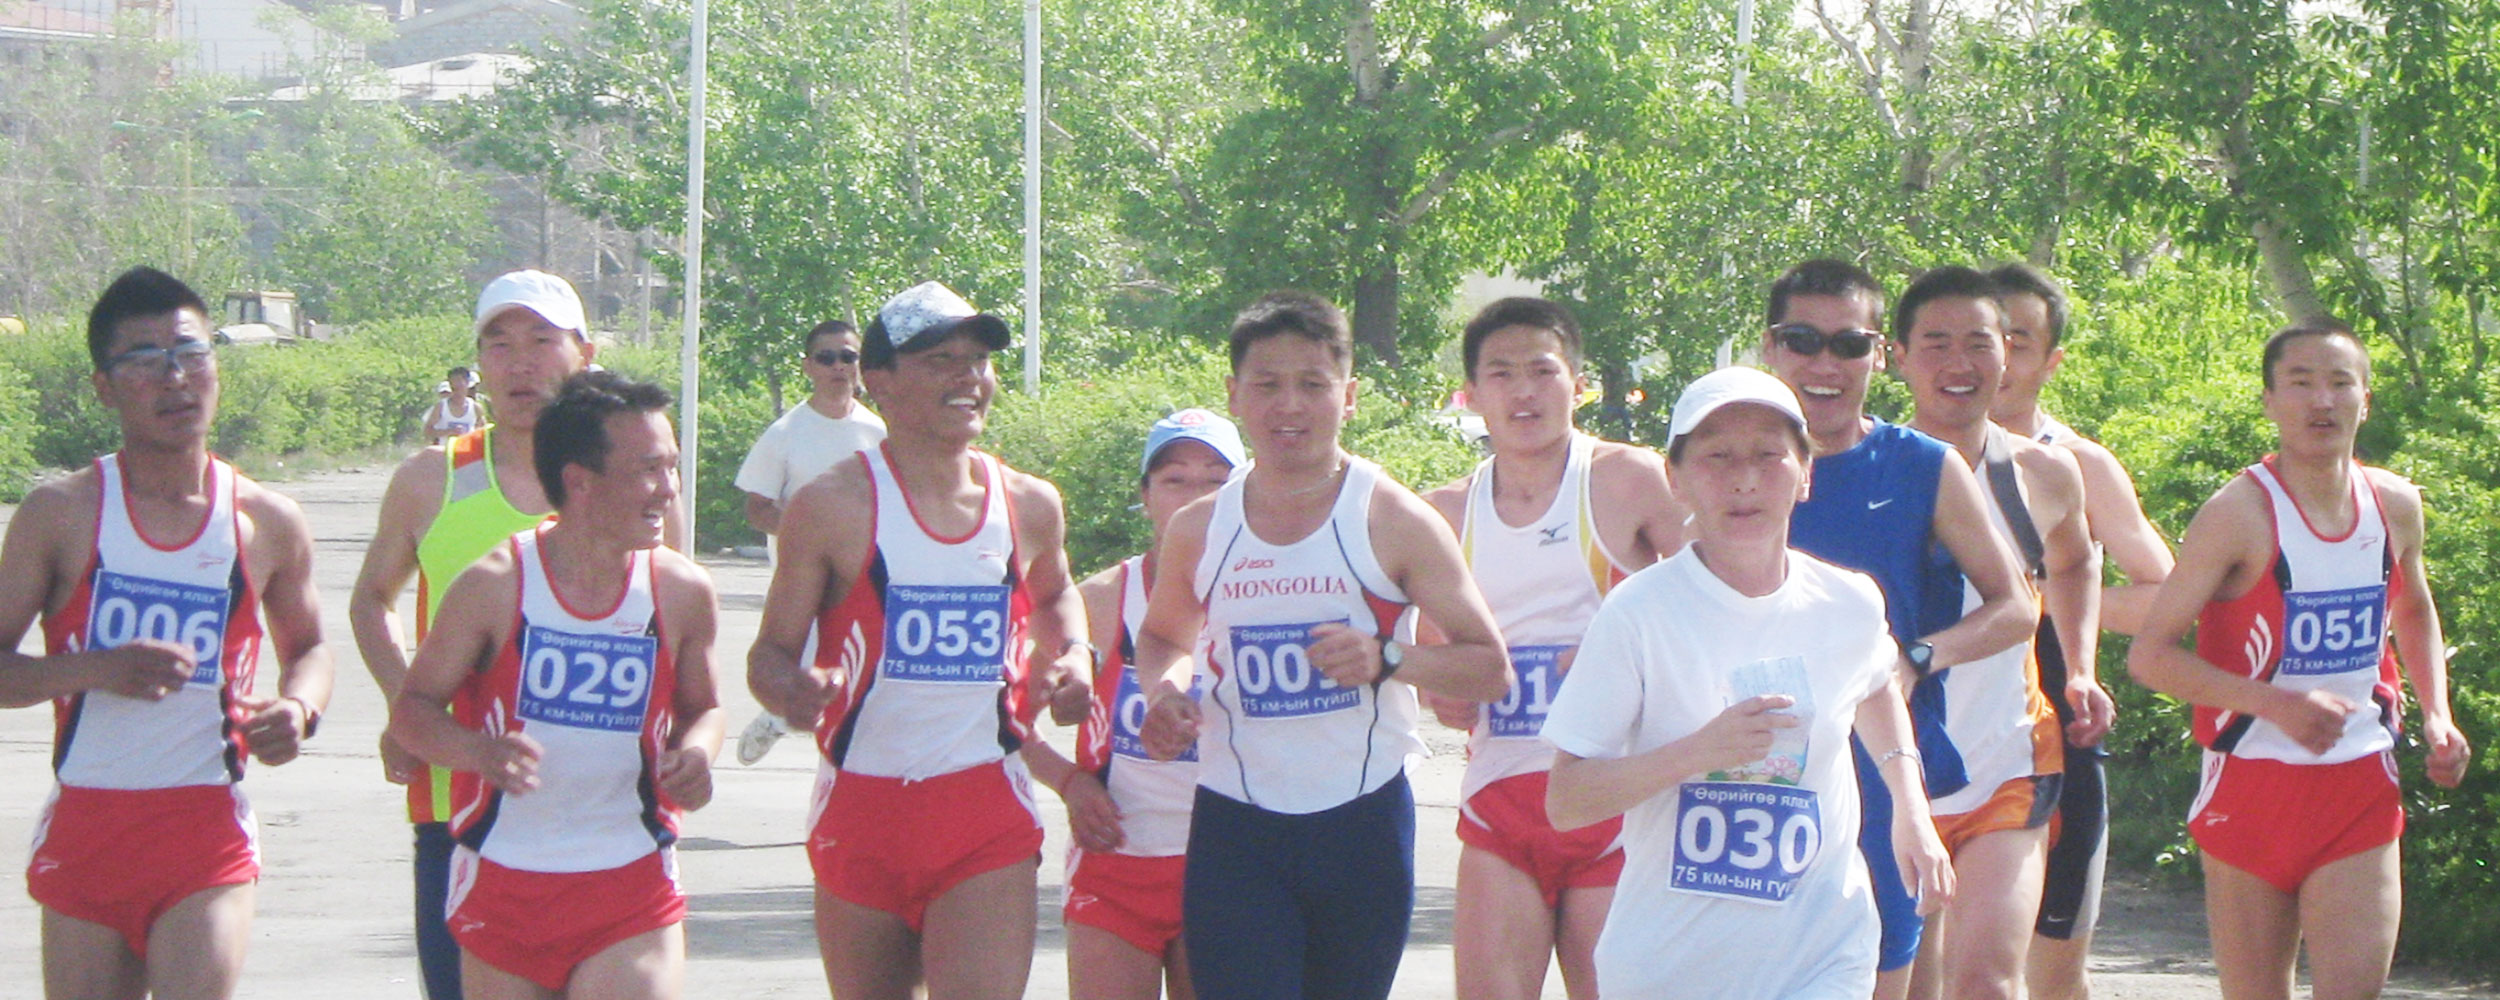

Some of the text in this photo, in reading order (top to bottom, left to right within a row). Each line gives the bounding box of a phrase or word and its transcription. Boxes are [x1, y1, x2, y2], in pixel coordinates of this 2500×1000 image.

[1222, 575, 1348, 600] MONGOLIA
[96, 596, 220, 664] 006
[896, 608, 1002, 657] 053
[2290, 605, 2377, 654] 051
[526, 647, 648, 708] 029
[887, 659, 906, 674] 75
[909, 663, 961, 677] км-ын
[1236, 642, 1338, 695] 00
[522, 701, 541, 715] 75
[1679, 804, 1820, 875] 030
[1674, 865, 1698, 883] 75
[1701, 871, 1763, 892] км-ын
